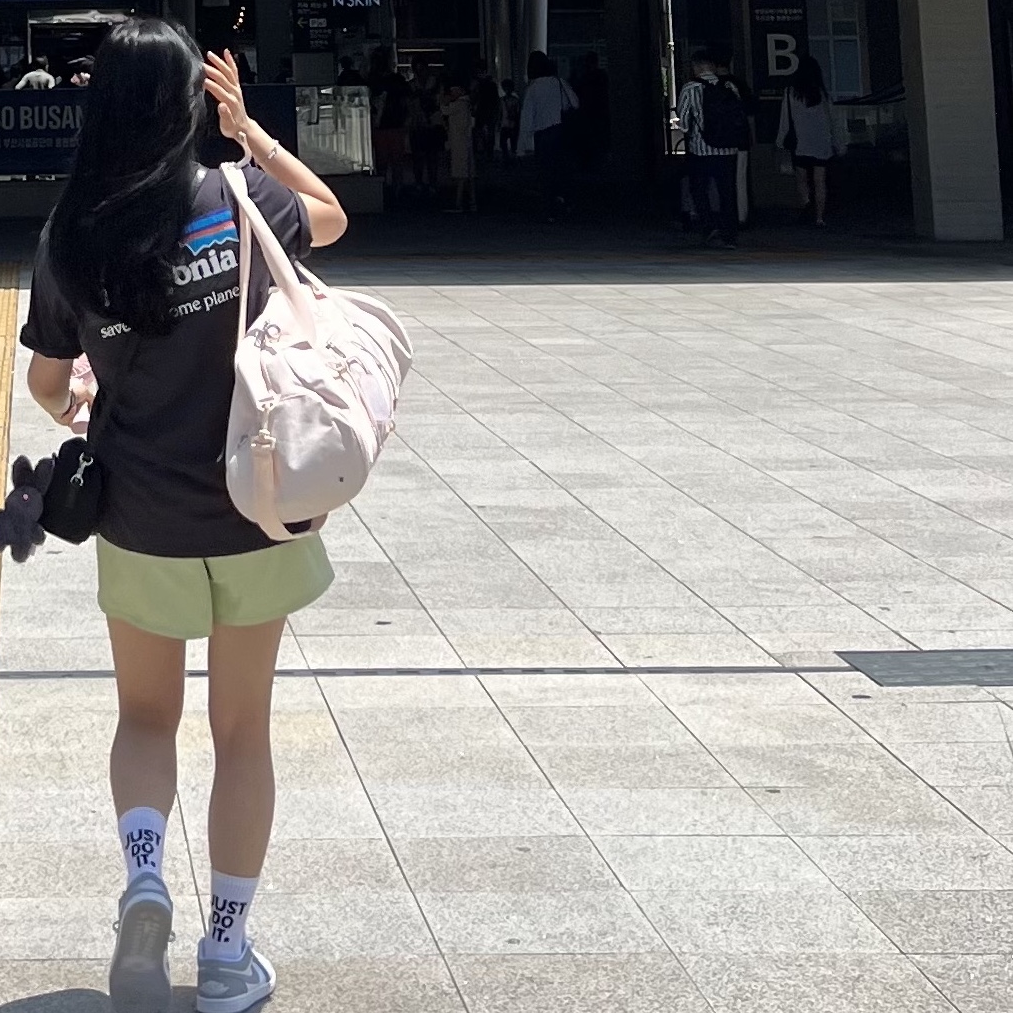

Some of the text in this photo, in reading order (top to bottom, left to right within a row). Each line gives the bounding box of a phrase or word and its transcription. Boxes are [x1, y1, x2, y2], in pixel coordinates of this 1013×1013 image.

[767, 33, 800, 77] B
[125, 829, 161, 851] JUST
[131, 842, 155, 858] DO
[136, 854, 157, 869] IT.
[211, 910, 235, 929] DO
[211, 927, 231, 943] IT.
